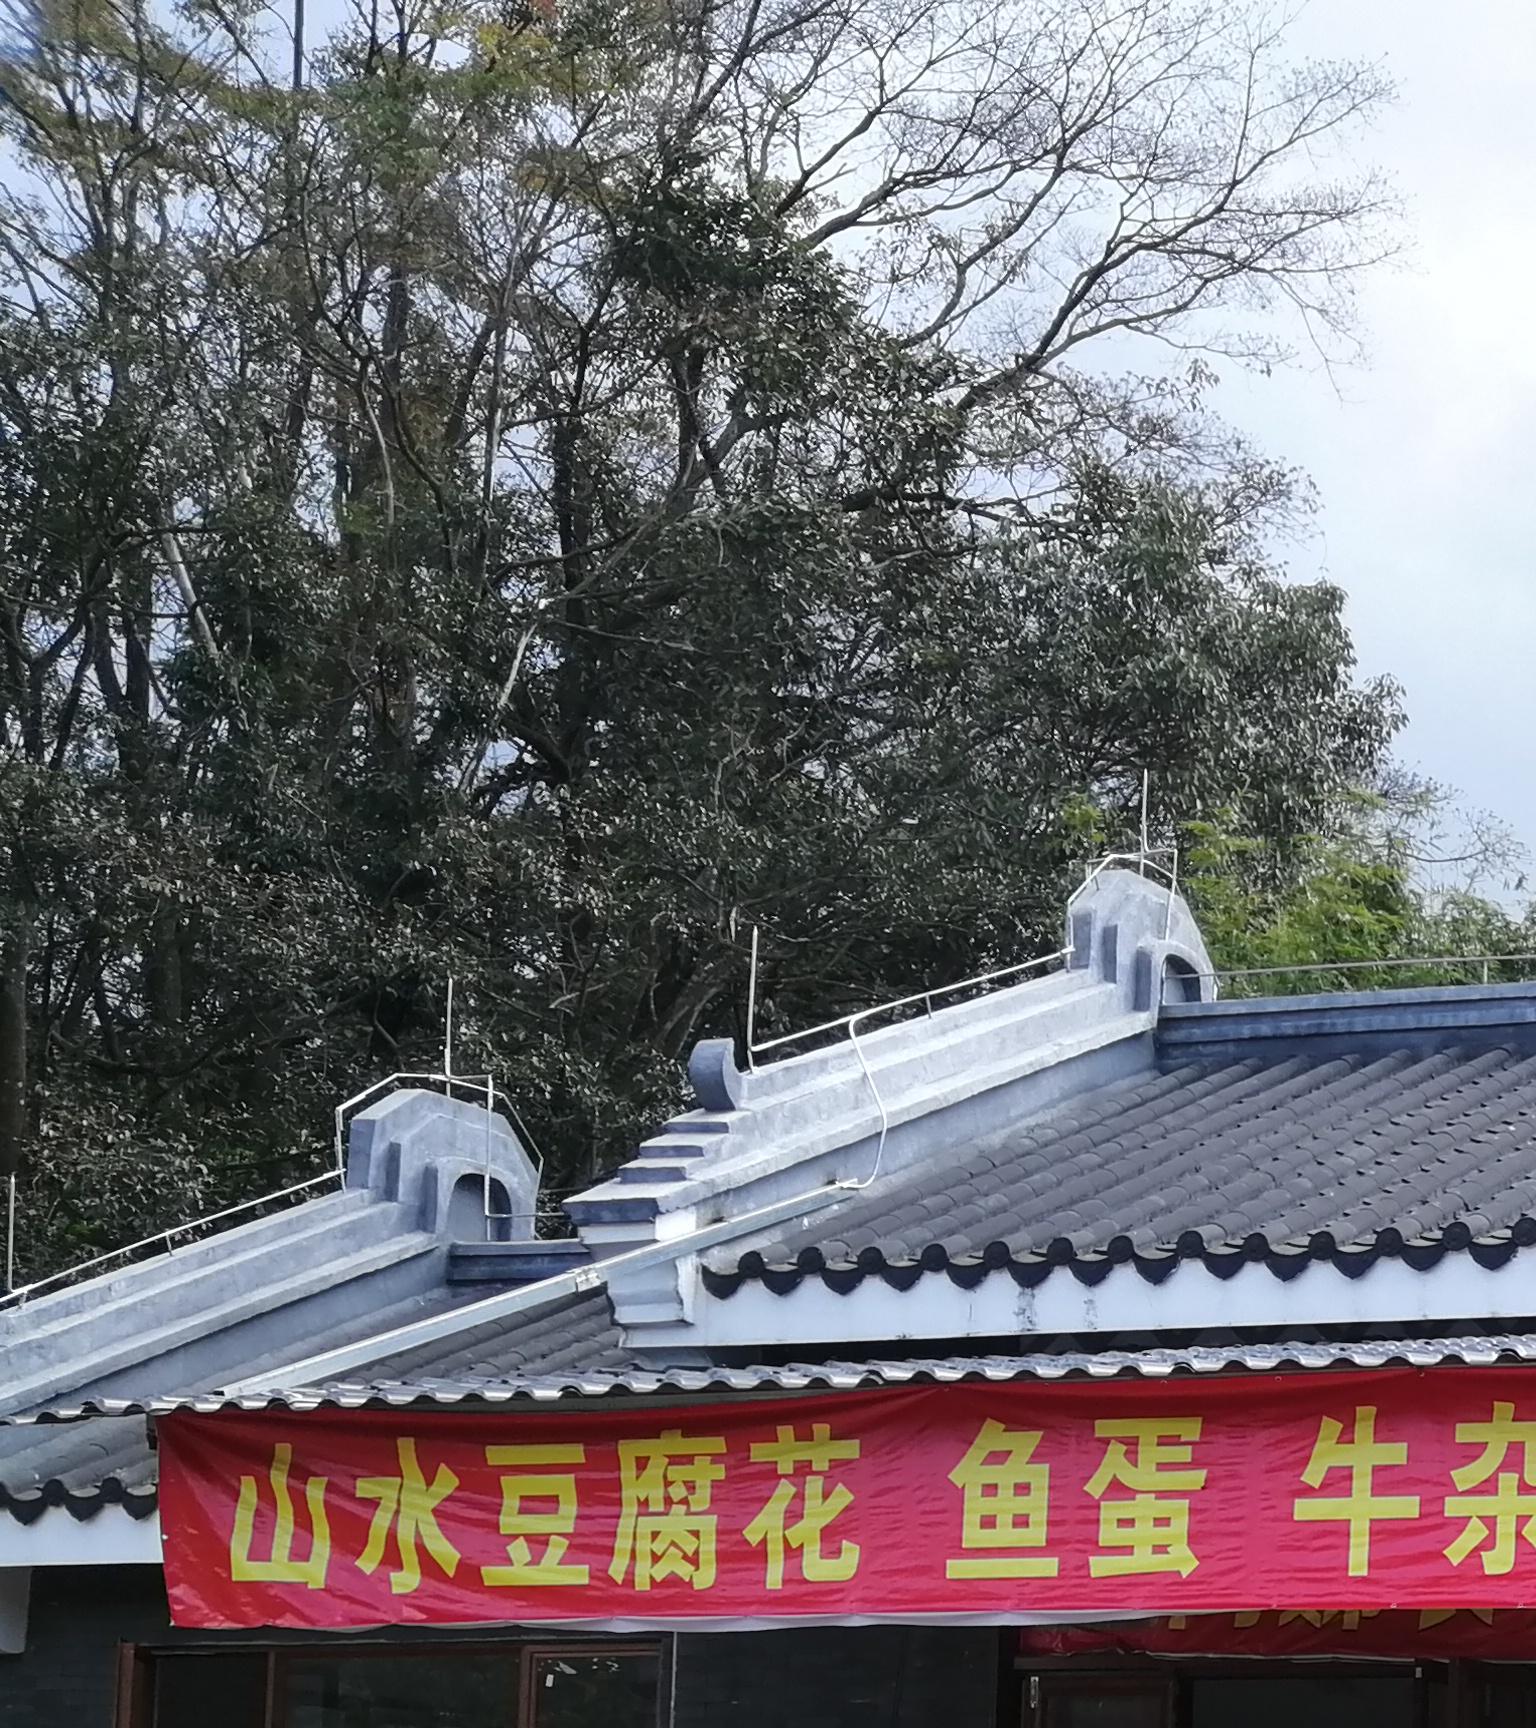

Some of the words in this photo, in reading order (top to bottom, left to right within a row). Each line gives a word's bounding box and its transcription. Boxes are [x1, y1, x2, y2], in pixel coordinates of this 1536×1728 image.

[230, 1423, 861, 1595] 山水豆腐花
[946, 1416, 1206, 1580] 鱼蛋
